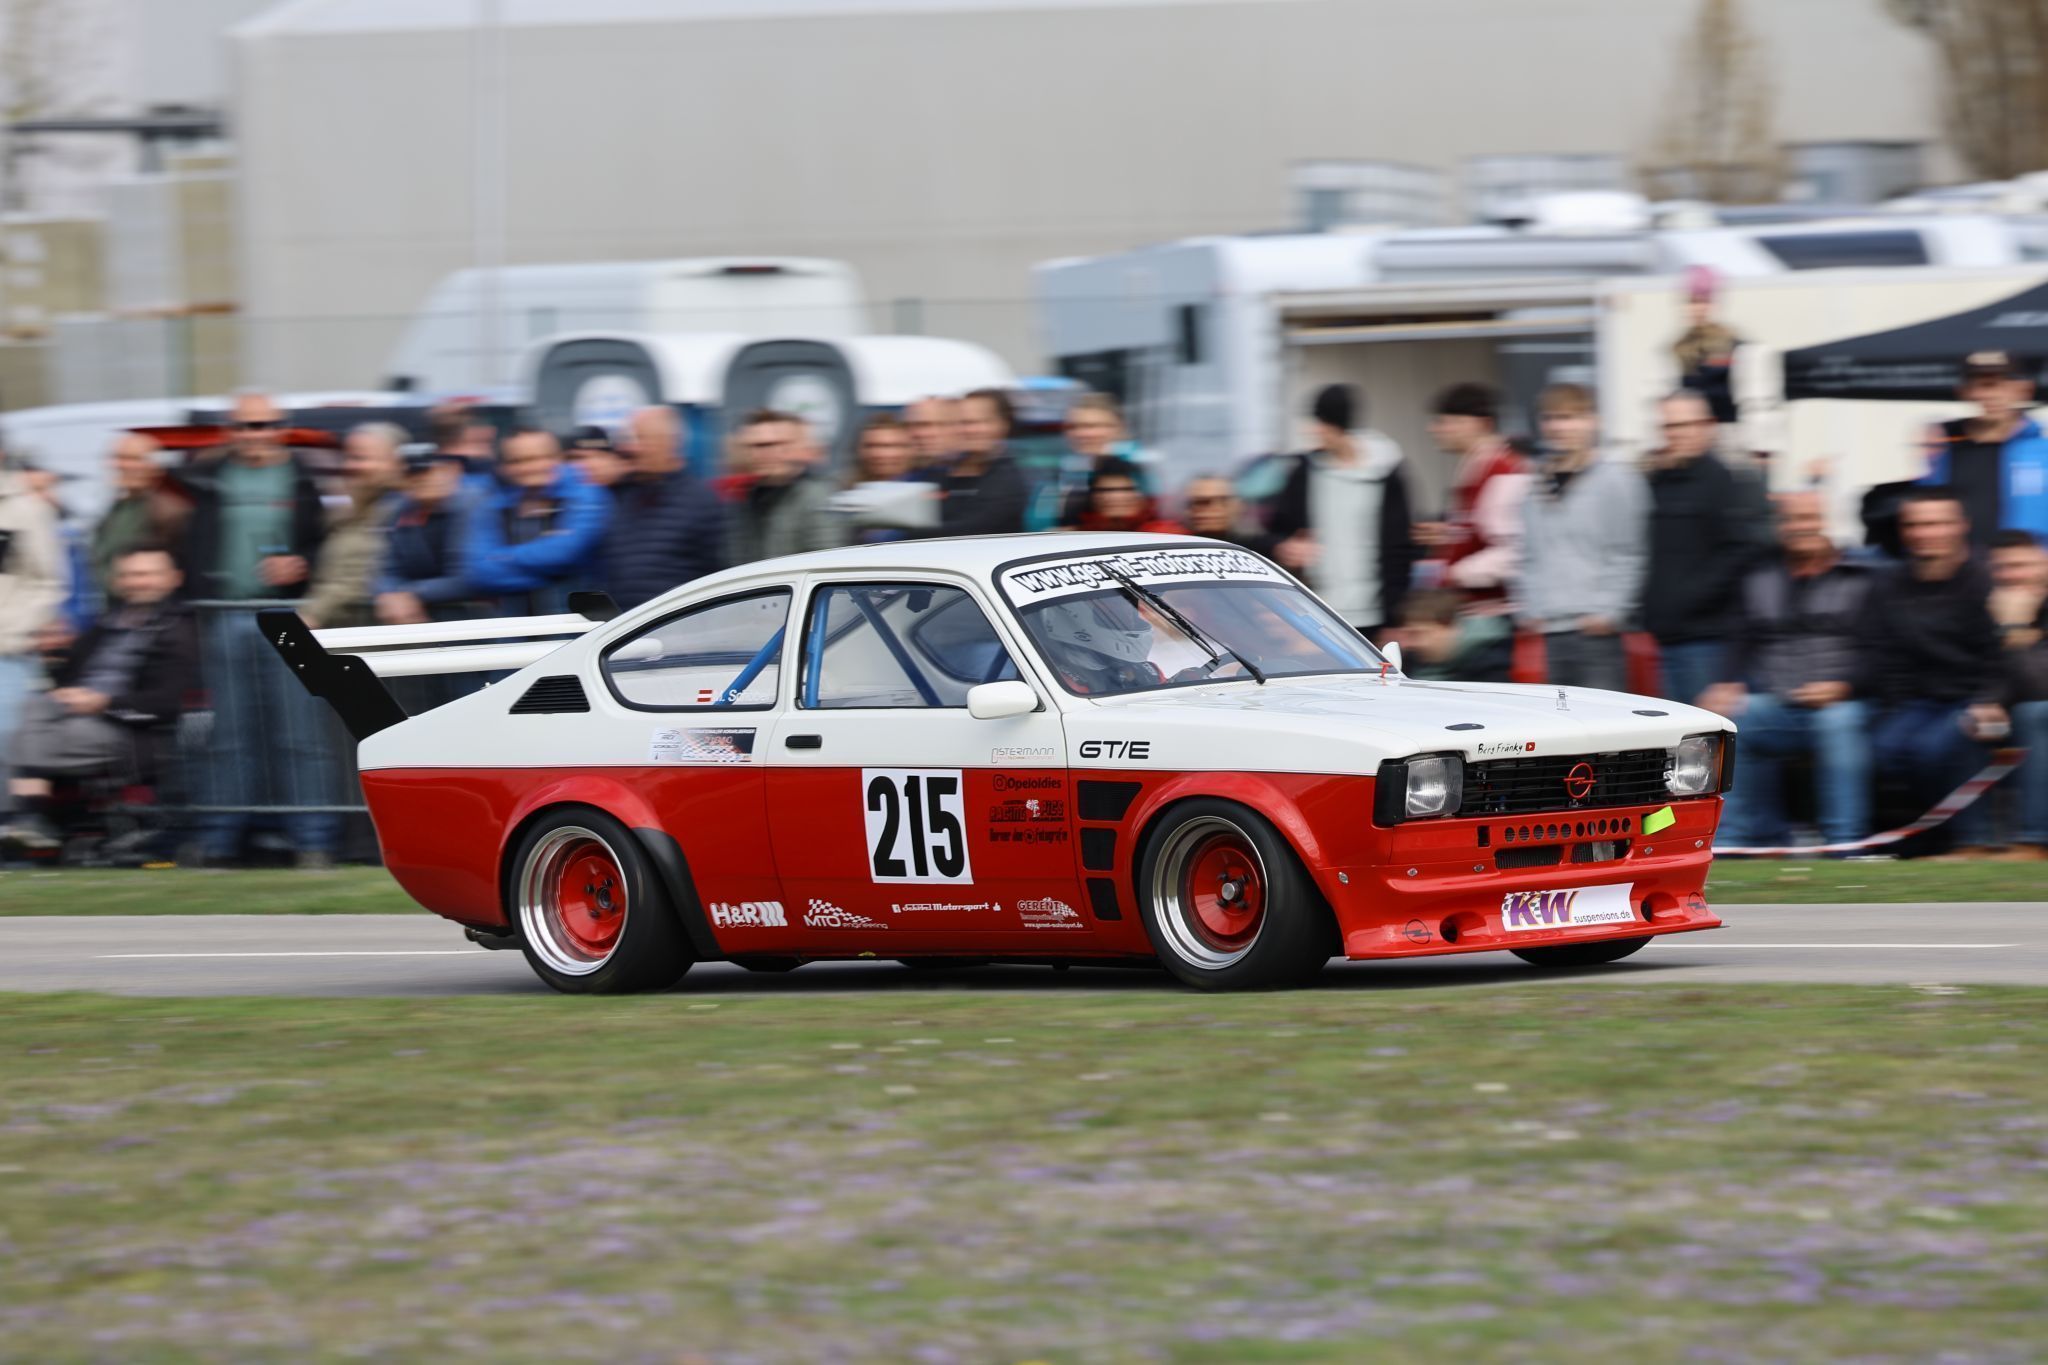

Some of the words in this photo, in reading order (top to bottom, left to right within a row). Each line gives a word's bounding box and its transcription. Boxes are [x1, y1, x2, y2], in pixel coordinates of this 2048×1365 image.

[1079, 741, 1150, 759] GT/E
[867, 775, 965, 878] 215
[710, 902, 764, 928] H&R
[932, 902, 990, 912] Motorsport
[1017, 900, 1064, 912] GERENT
[1509, 890, 1579, 927] KW
[1573, 910, 1631, 924] suspensions.de
[803, 915, 841, 928] MTO
